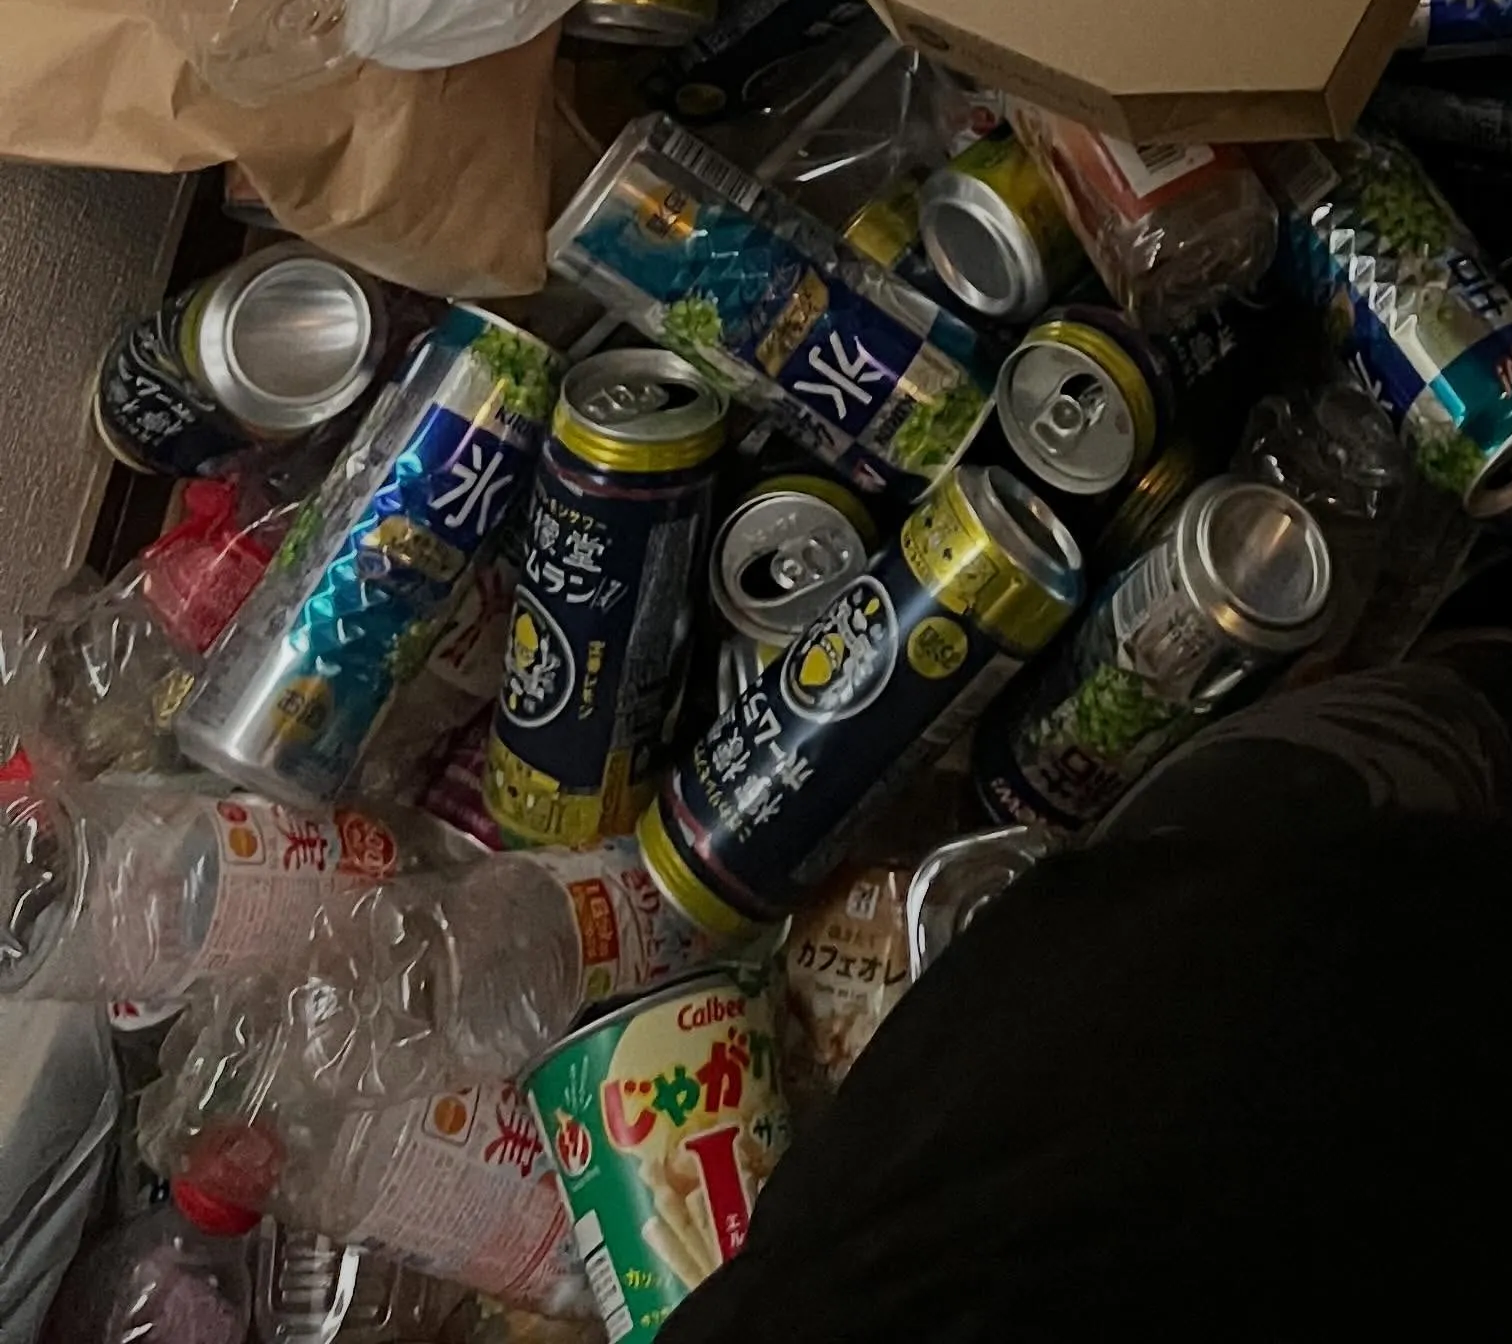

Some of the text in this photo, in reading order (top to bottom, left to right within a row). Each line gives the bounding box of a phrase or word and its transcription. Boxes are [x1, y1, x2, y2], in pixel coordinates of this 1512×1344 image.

[429, 441, 512, 537] 氷
[797, 936, 908, 988] カフェオレ
[677, 996, 748, 1033] Calbee
[603, 1026, 776, 1150] じゃがり
